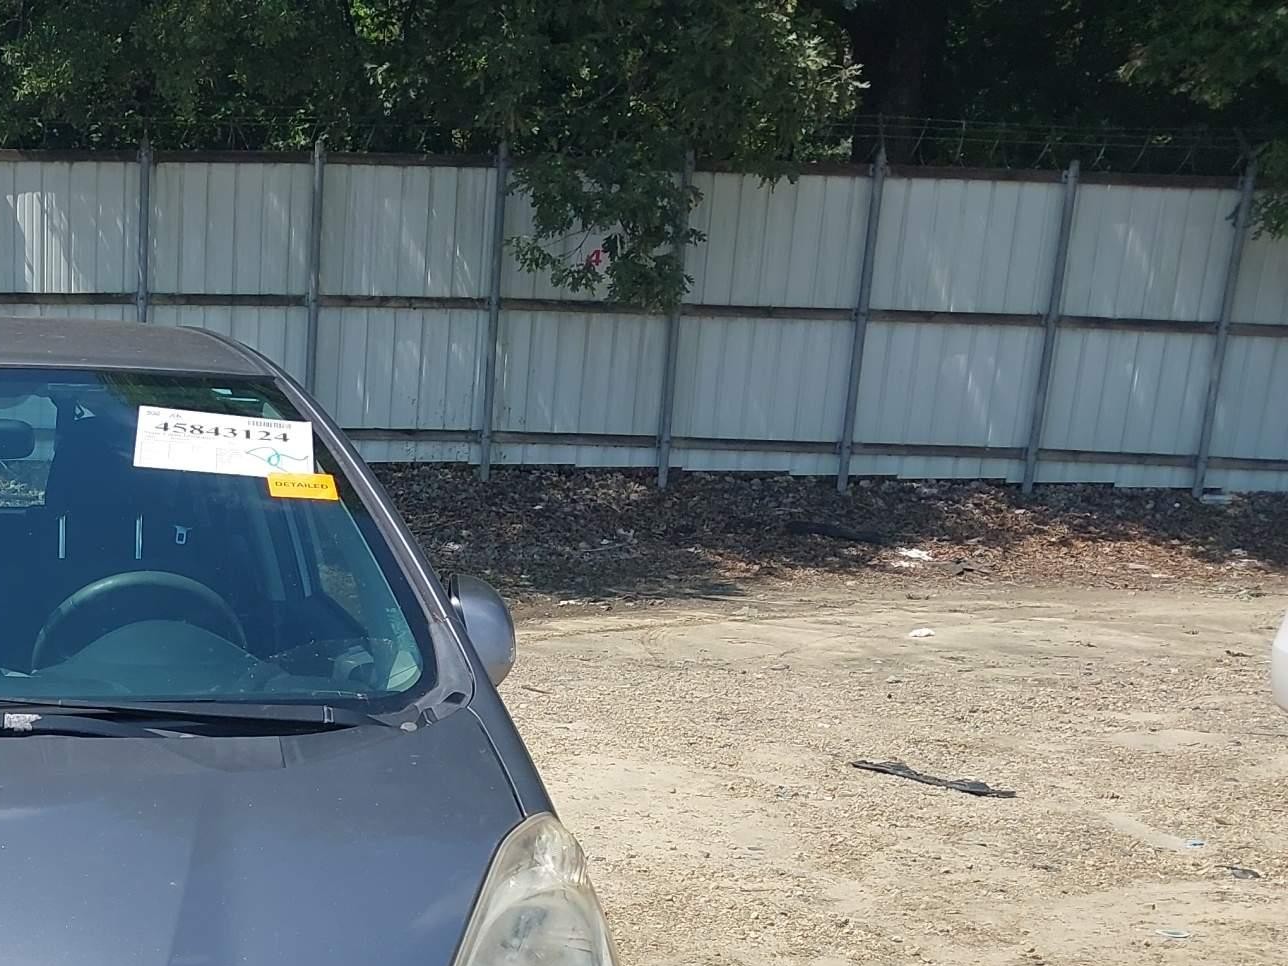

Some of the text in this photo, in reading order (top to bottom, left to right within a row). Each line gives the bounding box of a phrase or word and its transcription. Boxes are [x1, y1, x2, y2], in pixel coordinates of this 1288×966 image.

[588, 249, 602, 266] 4
[155, 421, 290, 442] 45843124
[274, 480, 329, 490] DETAILED
